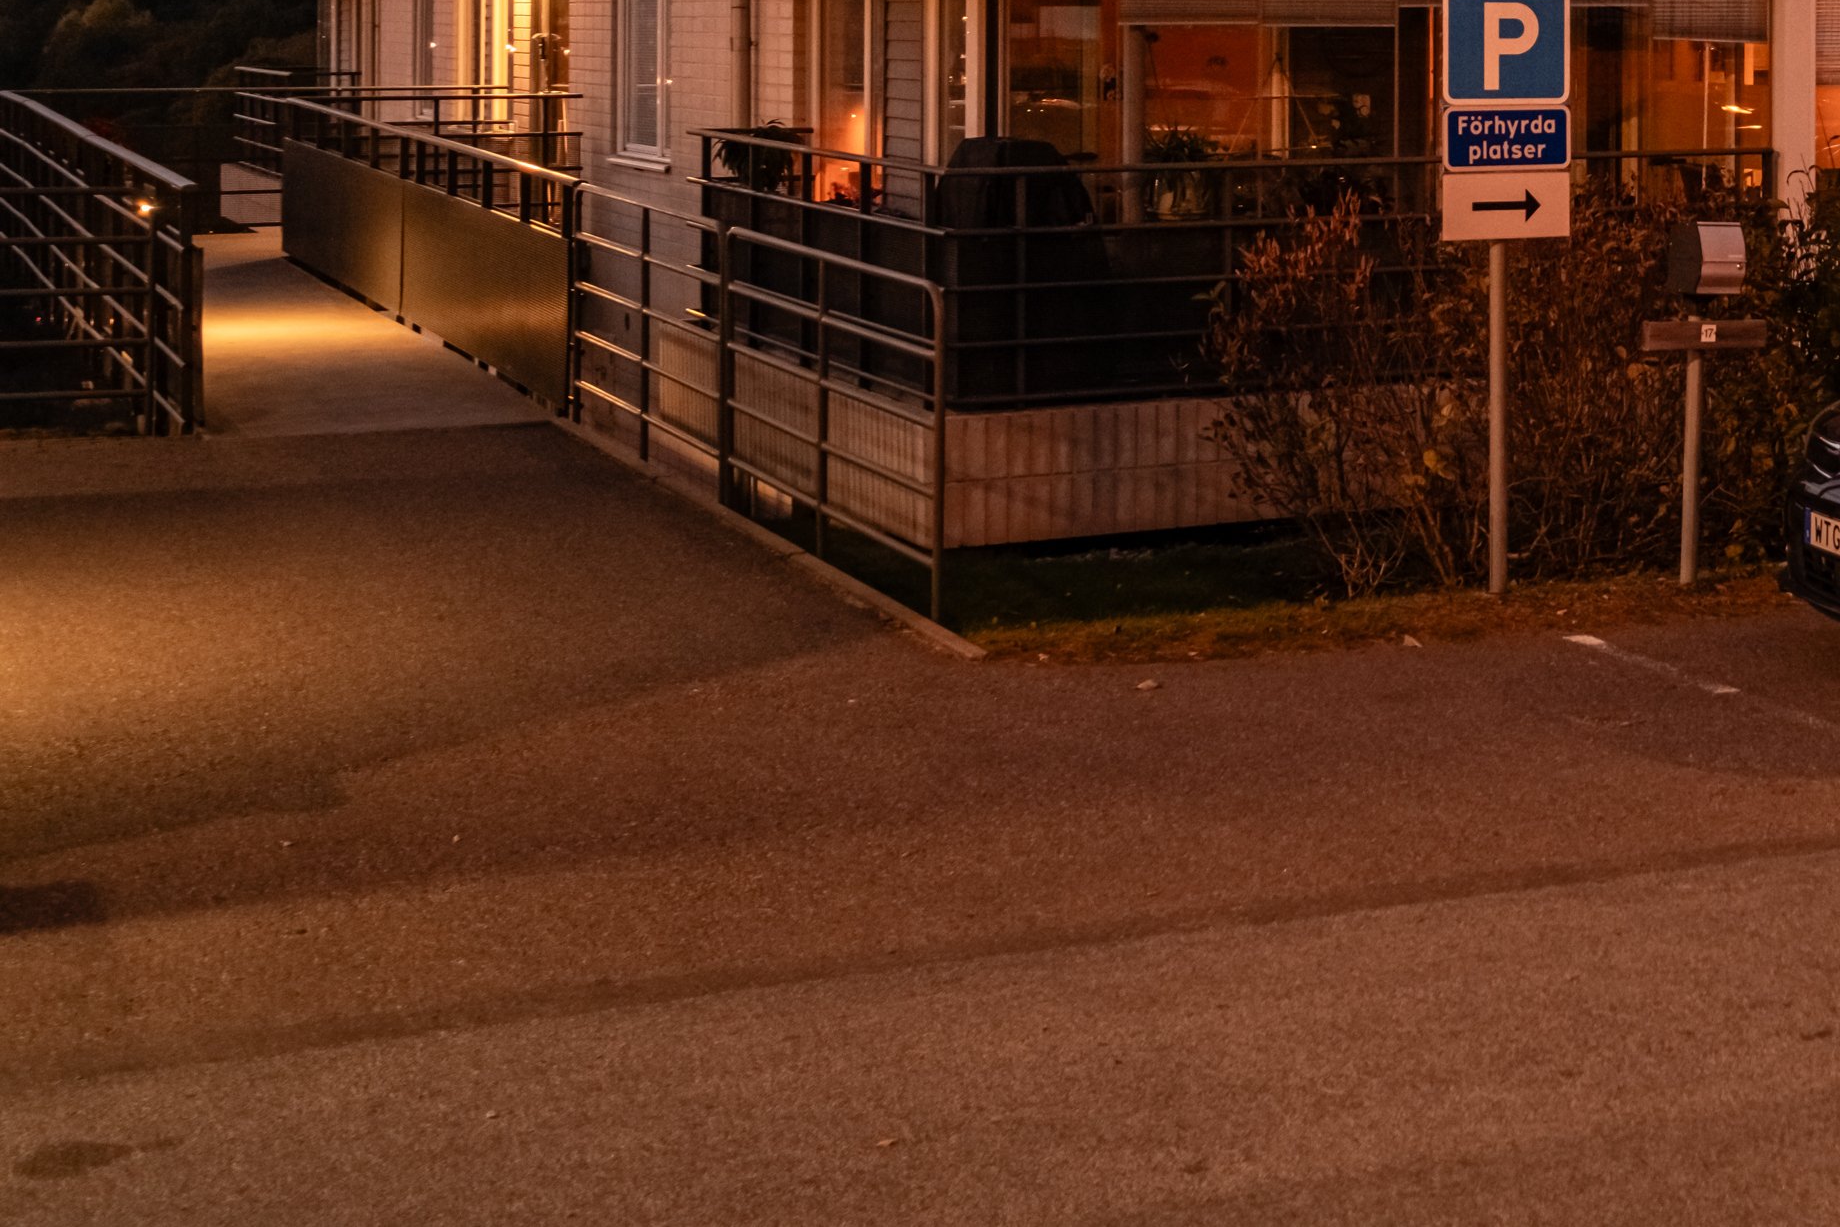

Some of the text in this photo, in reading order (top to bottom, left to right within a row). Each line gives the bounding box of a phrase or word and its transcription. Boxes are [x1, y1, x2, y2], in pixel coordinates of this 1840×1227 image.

[1483, 1, 1540, 91] P
[1457, 115, 1556, 138] Förhyrda
[1468, 141, 1546, 164] platser
[1704, 328, 1714, 338] 17
